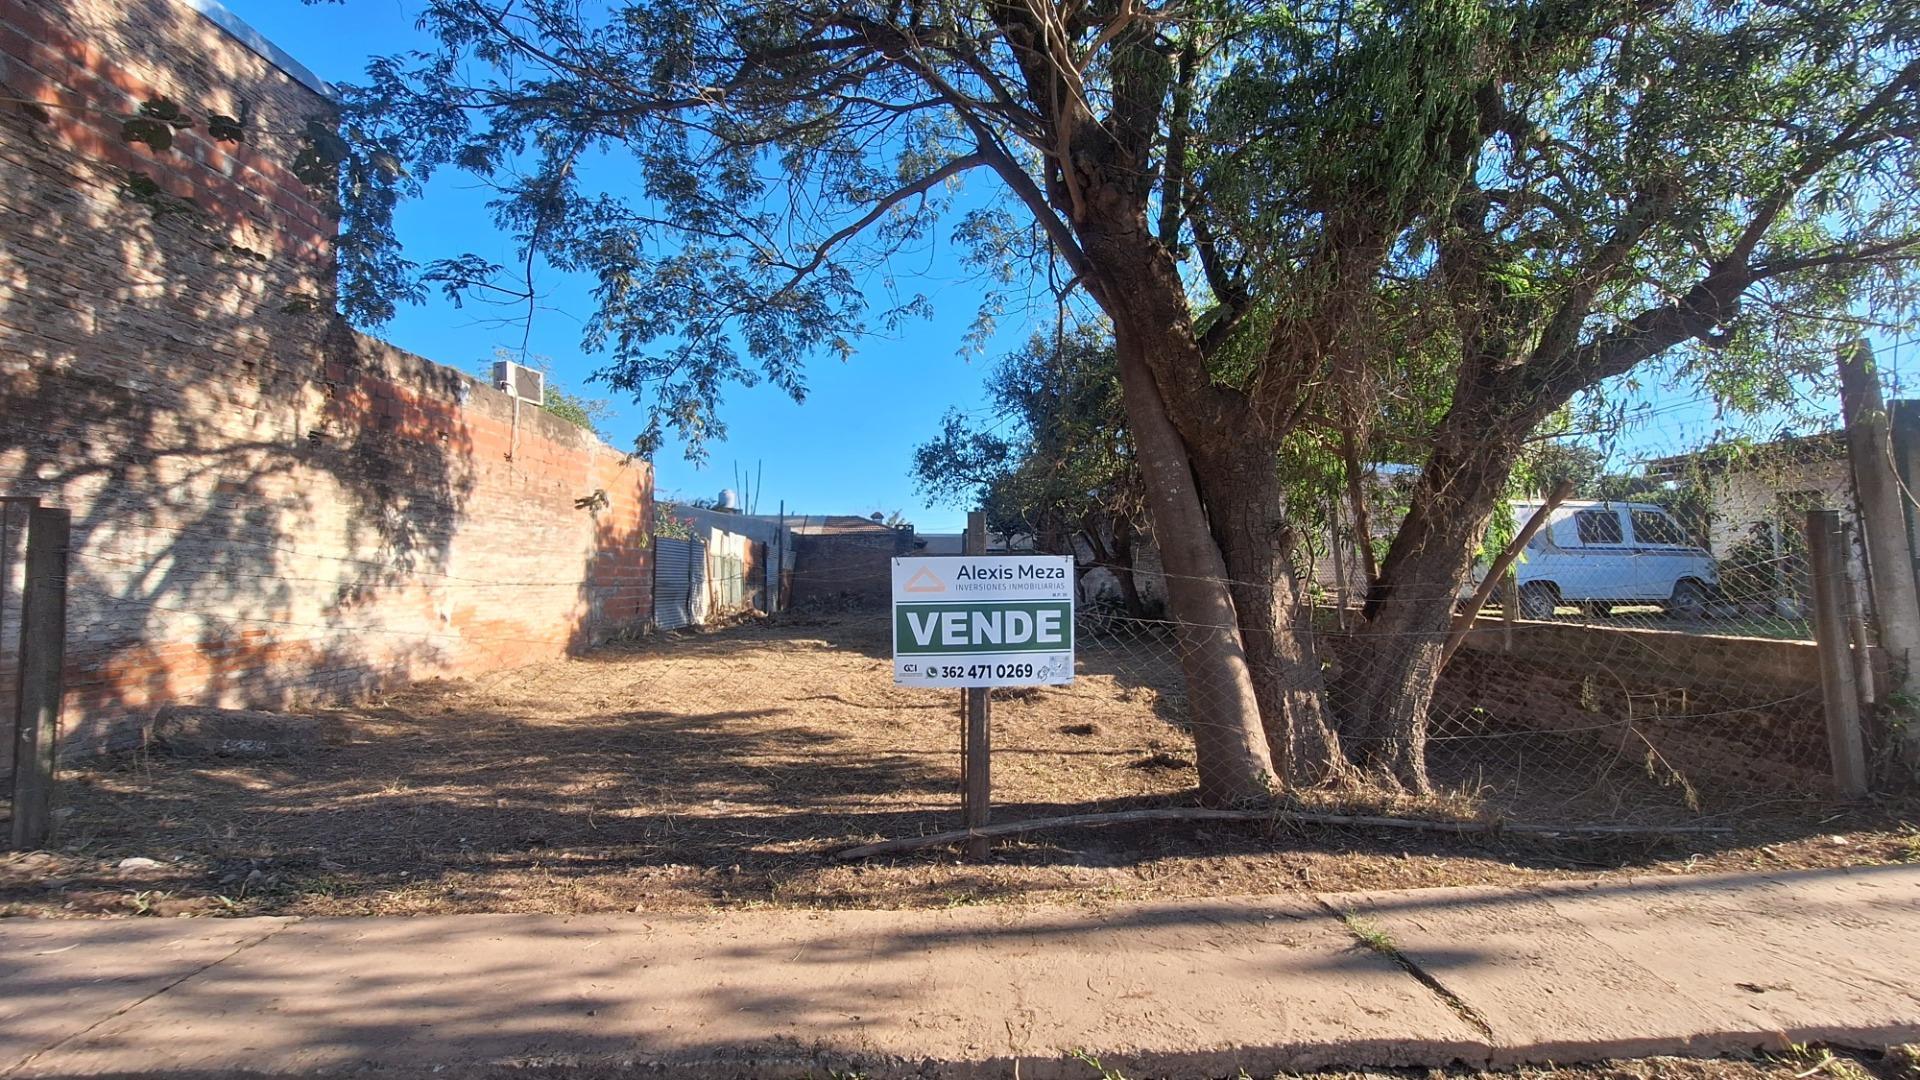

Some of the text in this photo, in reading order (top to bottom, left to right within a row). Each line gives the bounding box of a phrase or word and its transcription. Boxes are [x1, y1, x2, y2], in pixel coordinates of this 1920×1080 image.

[957, 564, 1065, 580] Alexis Meza
[955, 581, 1065, 591] INVERSIONES INMOBILIARIAS
[906, 610, 1062, 646] VENDE
[942, 663, 1033, 678] 362 471 0269
